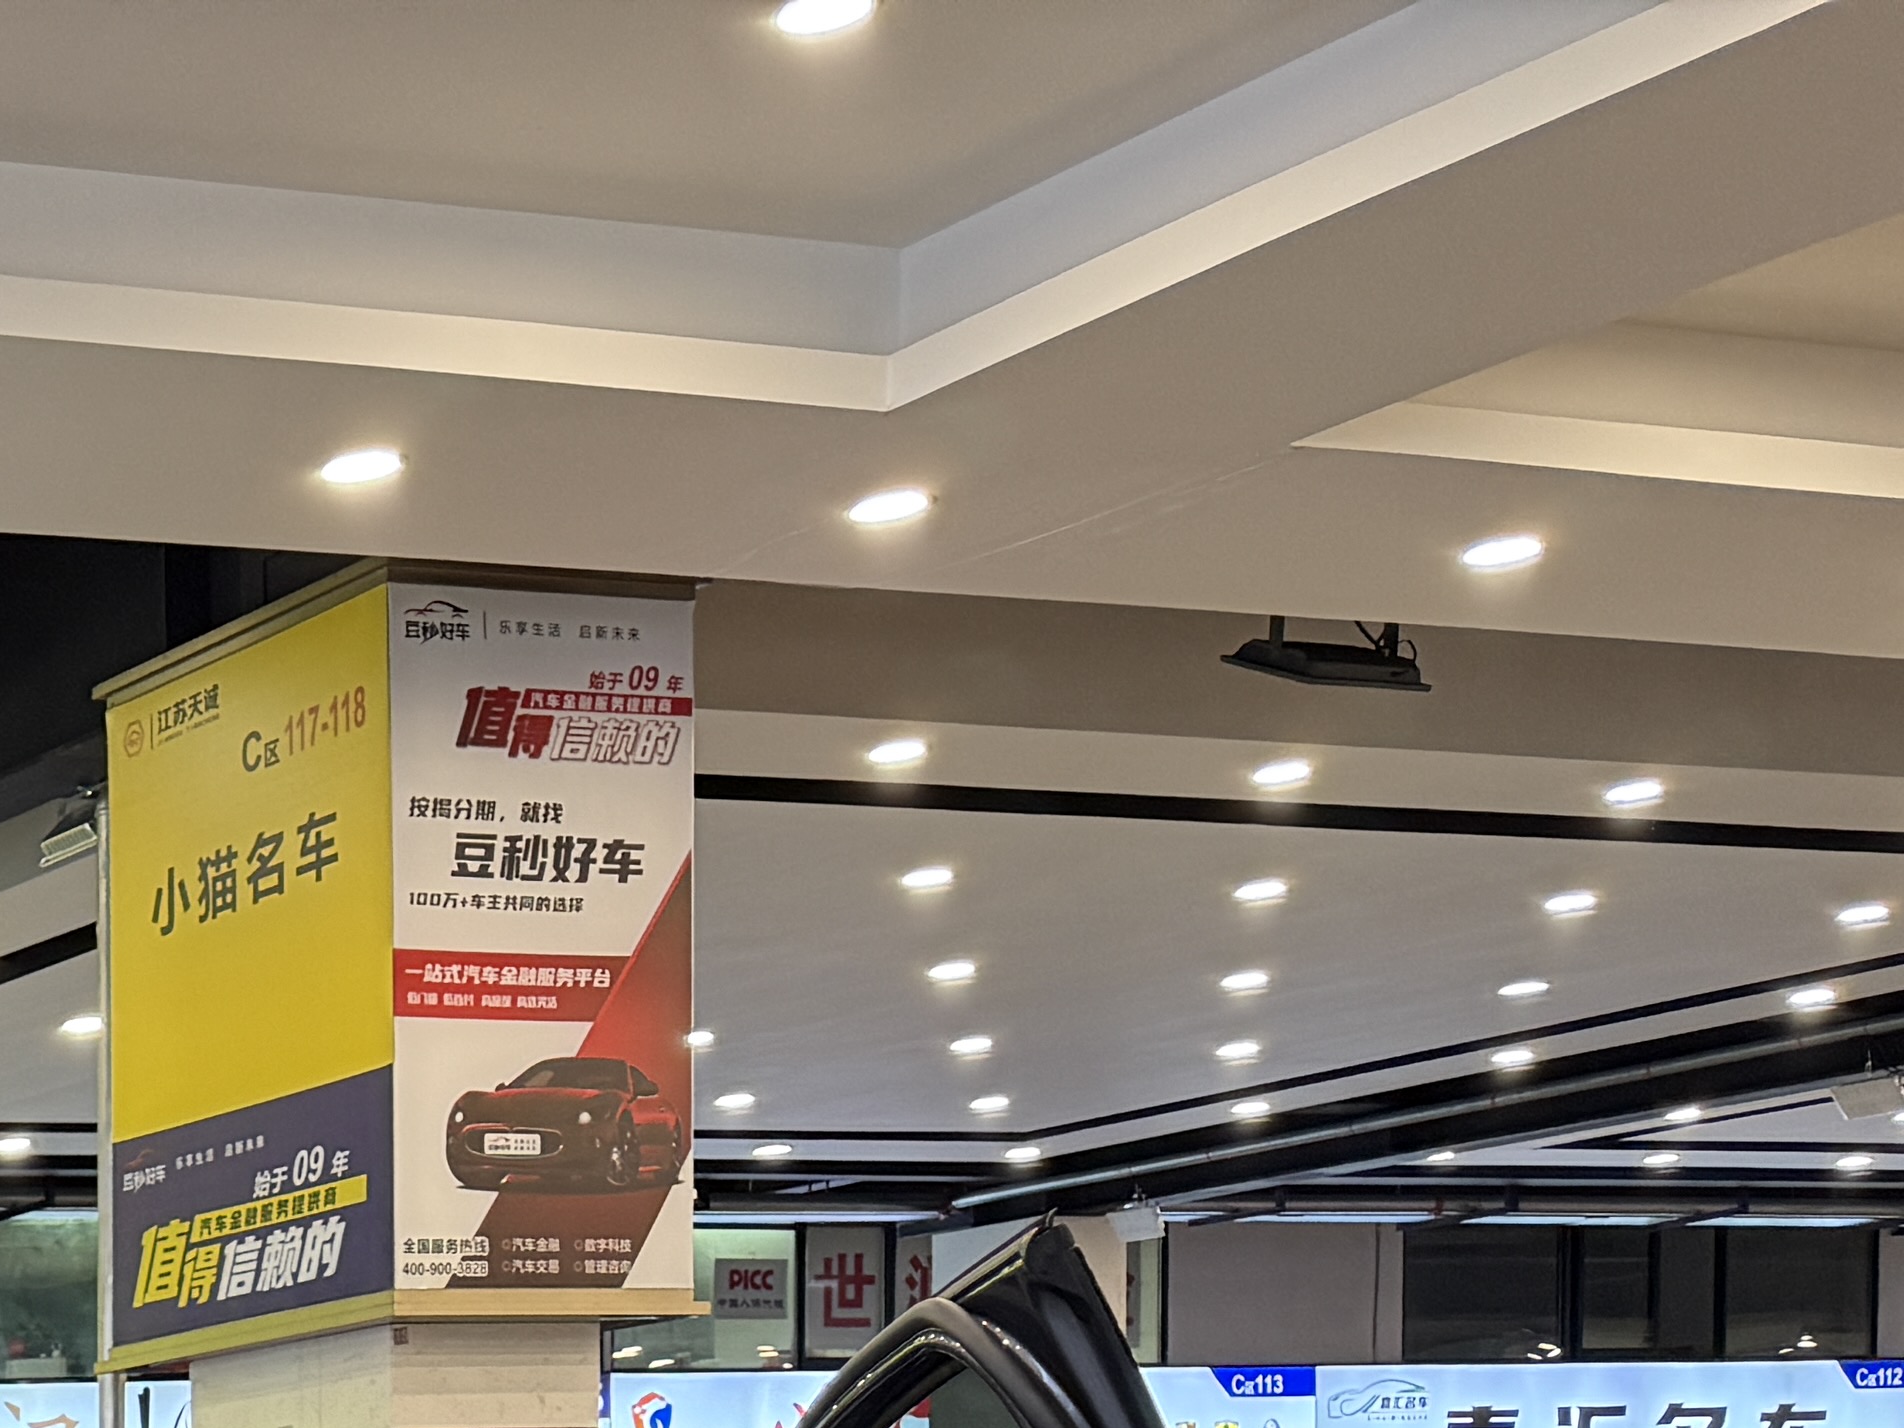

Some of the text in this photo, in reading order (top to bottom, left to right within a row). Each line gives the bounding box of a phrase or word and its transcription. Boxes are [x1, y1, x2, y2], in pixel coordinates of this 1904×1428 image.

[456, 686, 681, 765] 值得信赖的
[150, 811, 340, 936] 小猫名车
[450, 831, 645, 885] 豆秒好车
[405, 963, 612, 988] 一站式汽车金融服务平台
[132, 1215, 347, 1309] 值得信赖的
[729, 1269, 775, 1291] PICC
